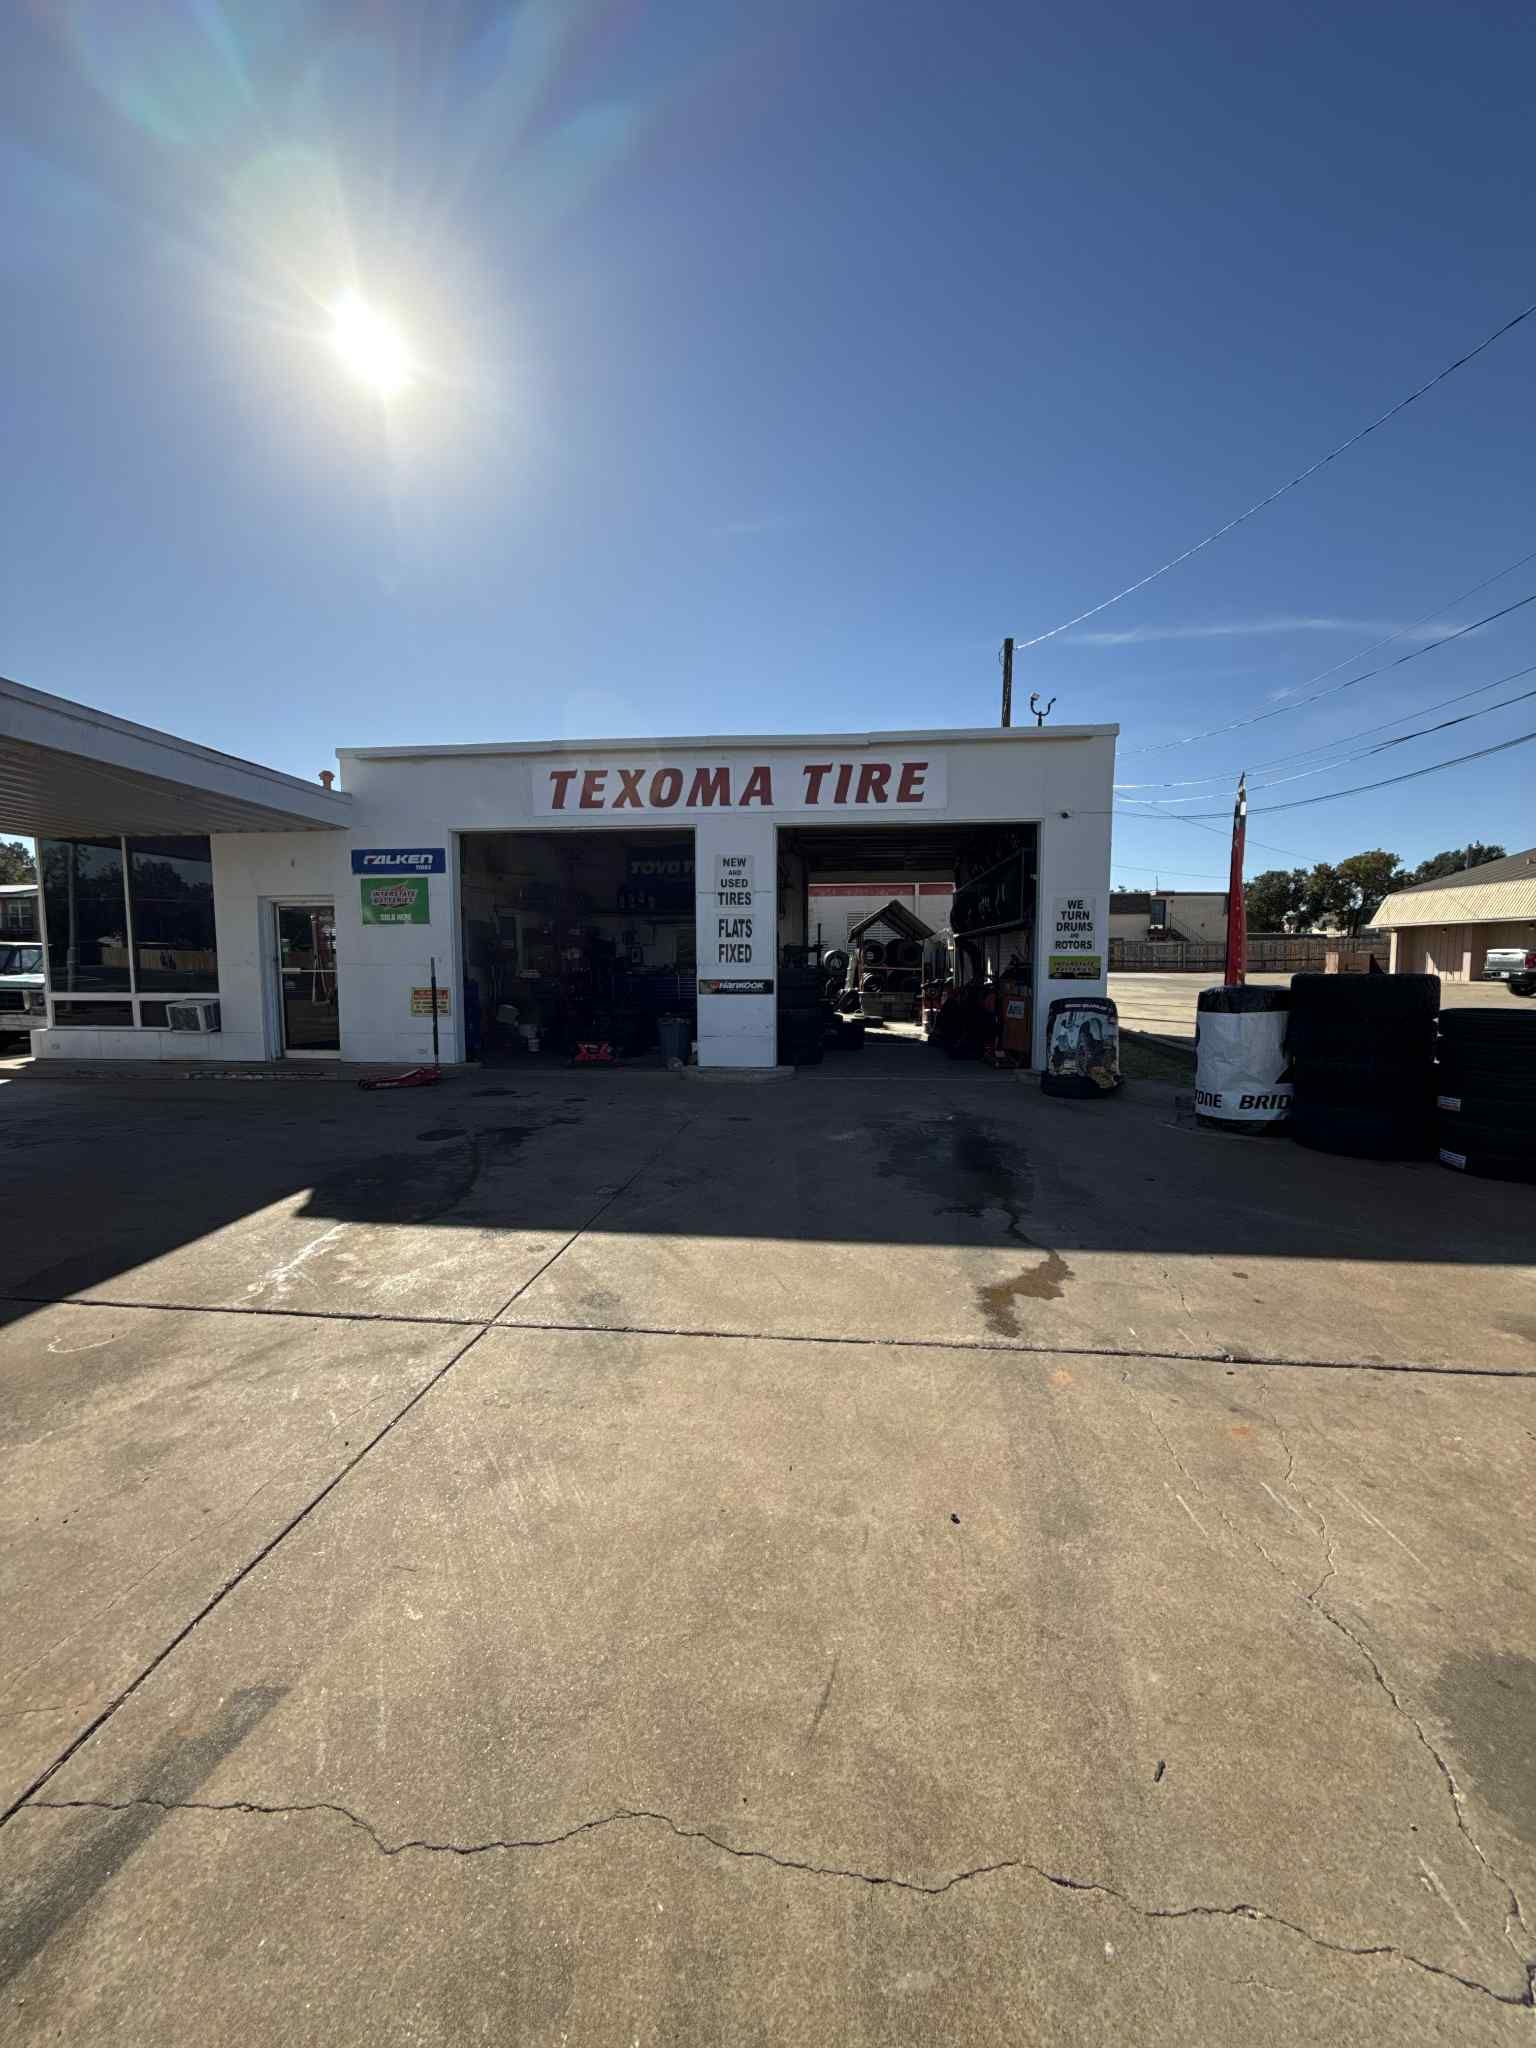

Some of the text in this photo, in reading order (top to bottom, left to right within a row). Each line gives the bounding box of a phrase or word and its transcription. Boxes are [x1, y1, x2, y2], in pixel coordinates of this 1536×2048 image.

[549, 762, 929, 809] TEXOMA TIRE
[363, 854, 434, 865] FALKEN
[722, 858, 747, 867] NEW
[720, 878, 749, 888] USED
[718, 892, 752, 906] TIRES
[1067, 899, 1084, 910] WE
[1061, 911, 1090, 921] TURN
[718, 918, 753, 938] FLATS
[1056, 922, 1094, 932] DRUMS
[1055, 941, 1093, 950] ROTORS
[718, 943, 753, 963] FIXED
[1240, 1094, 1296, 1110] BRID
